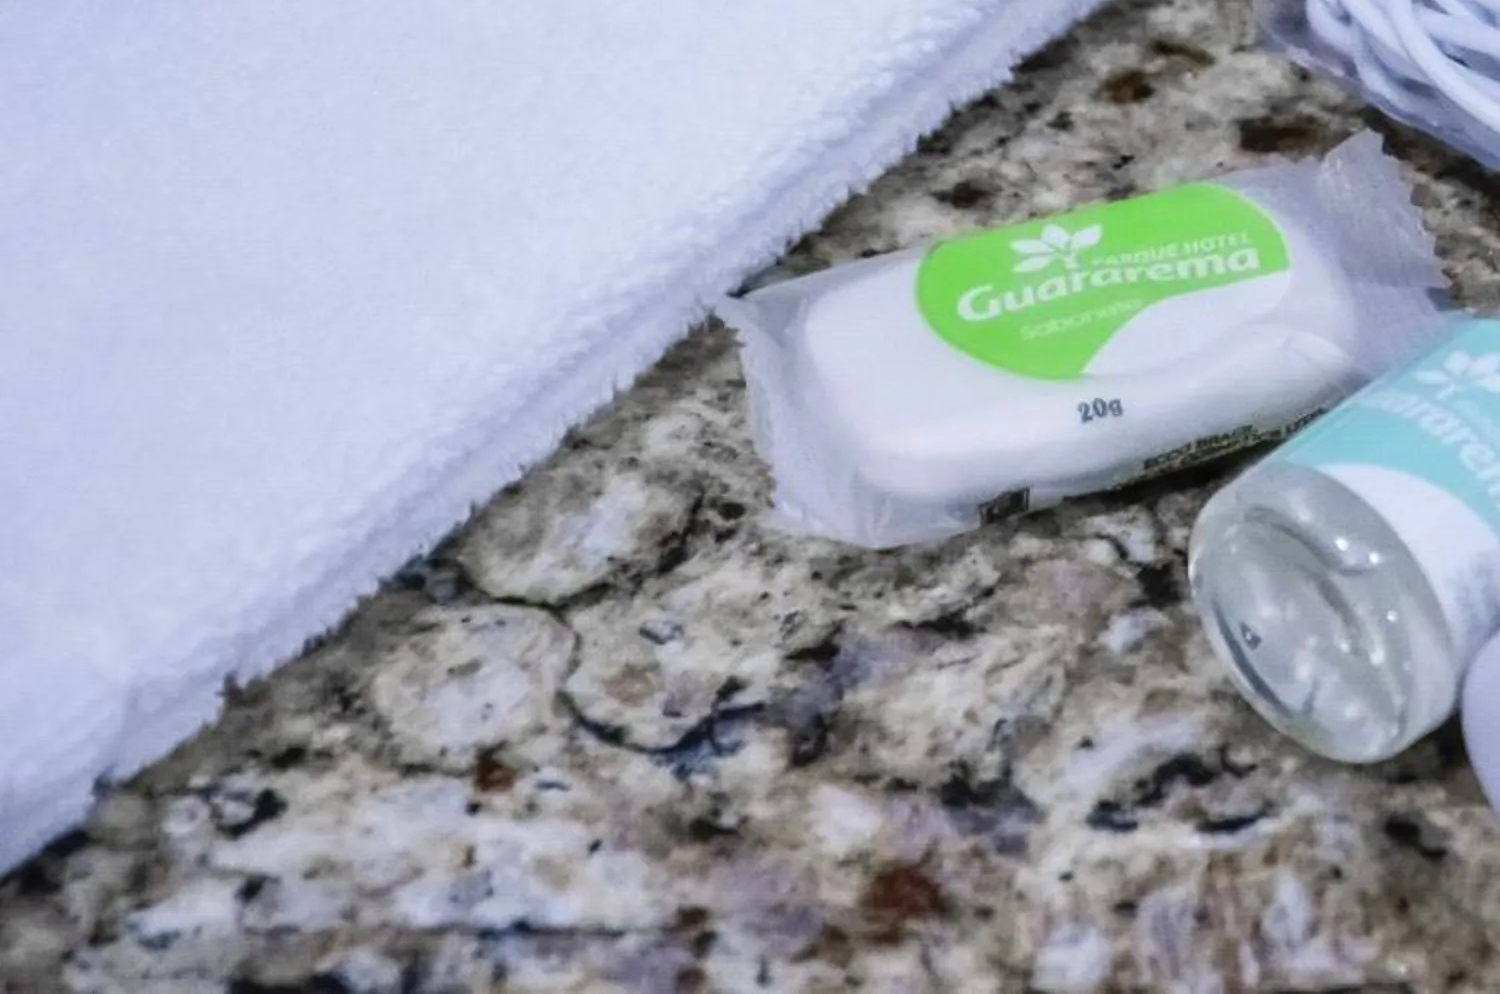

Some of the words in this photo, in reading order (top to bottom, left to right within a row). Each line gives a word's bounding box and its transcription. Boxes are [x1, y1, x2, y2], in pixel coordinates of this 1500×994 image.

[1181, 230, 1253, 255] HOTEL
[956, 246, 1261, 323] Guararema
[1075, 397, 1124, 424] 20g
